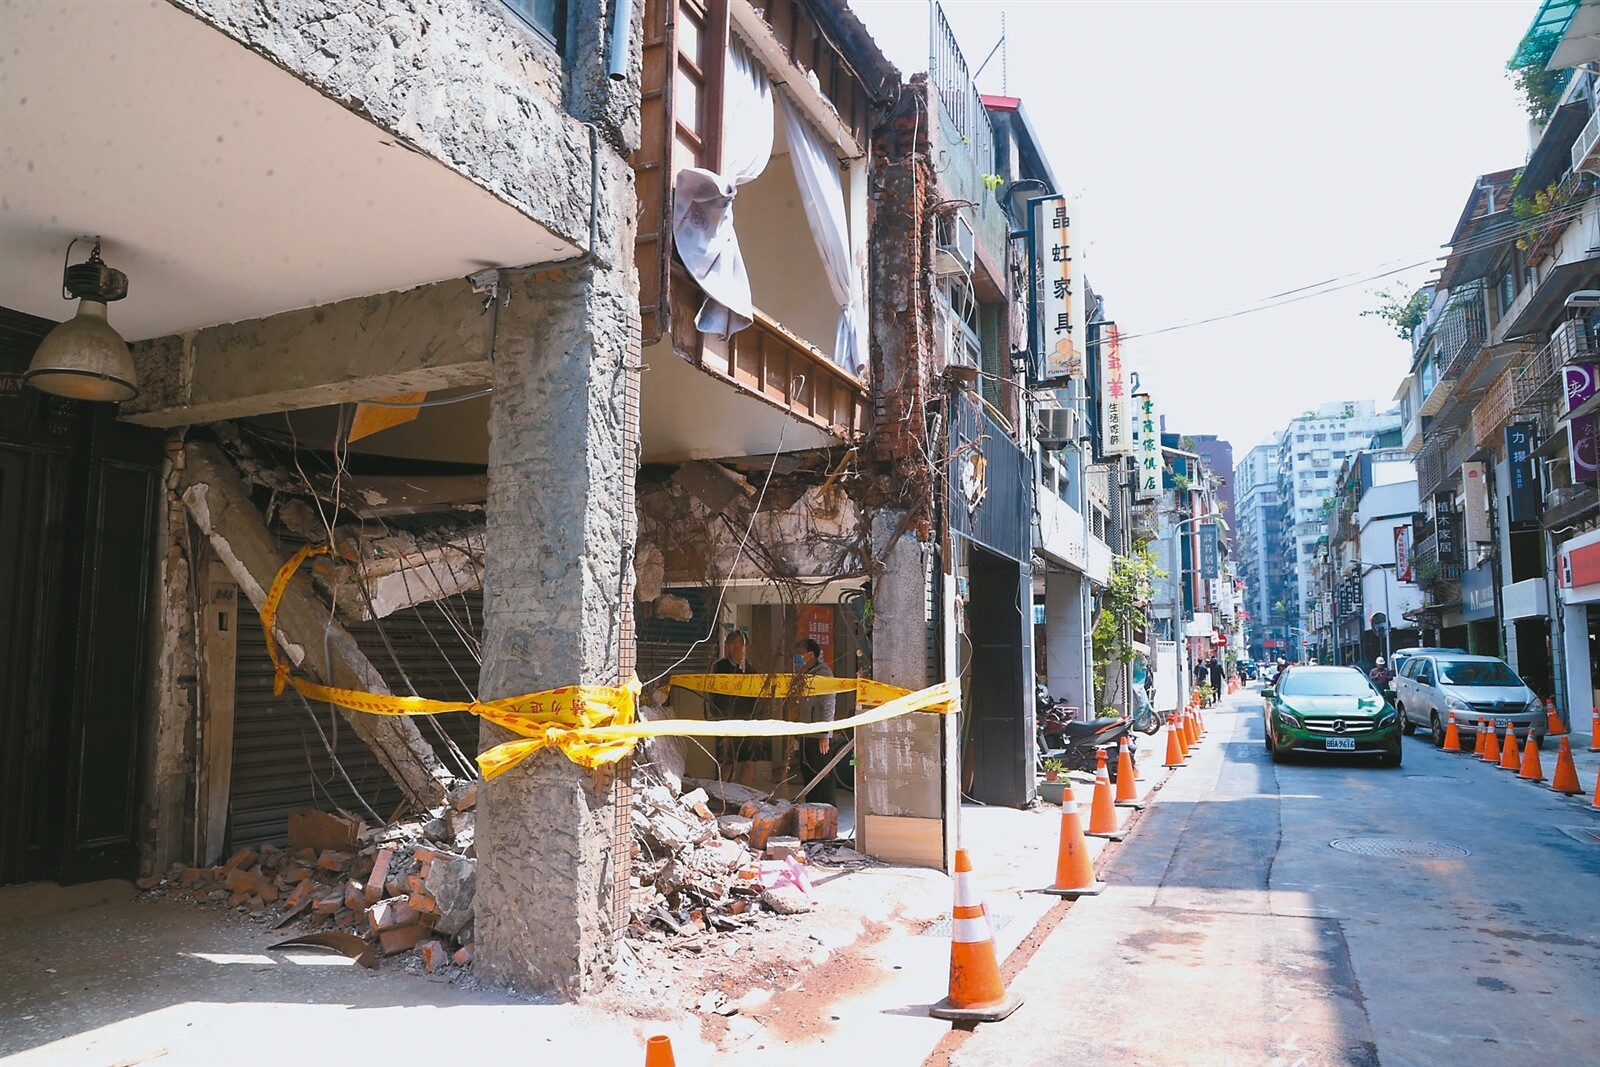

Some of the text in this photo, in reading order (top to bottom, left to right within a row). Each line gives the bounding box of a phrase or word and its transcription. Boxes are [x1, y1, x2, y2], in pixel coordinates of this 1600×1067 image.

[1052, 207, 1073, 335] 晶虹家具
[1437, 501, 1451, 553] 植木家居
[509, 699, 586, 716] 請勿進入
